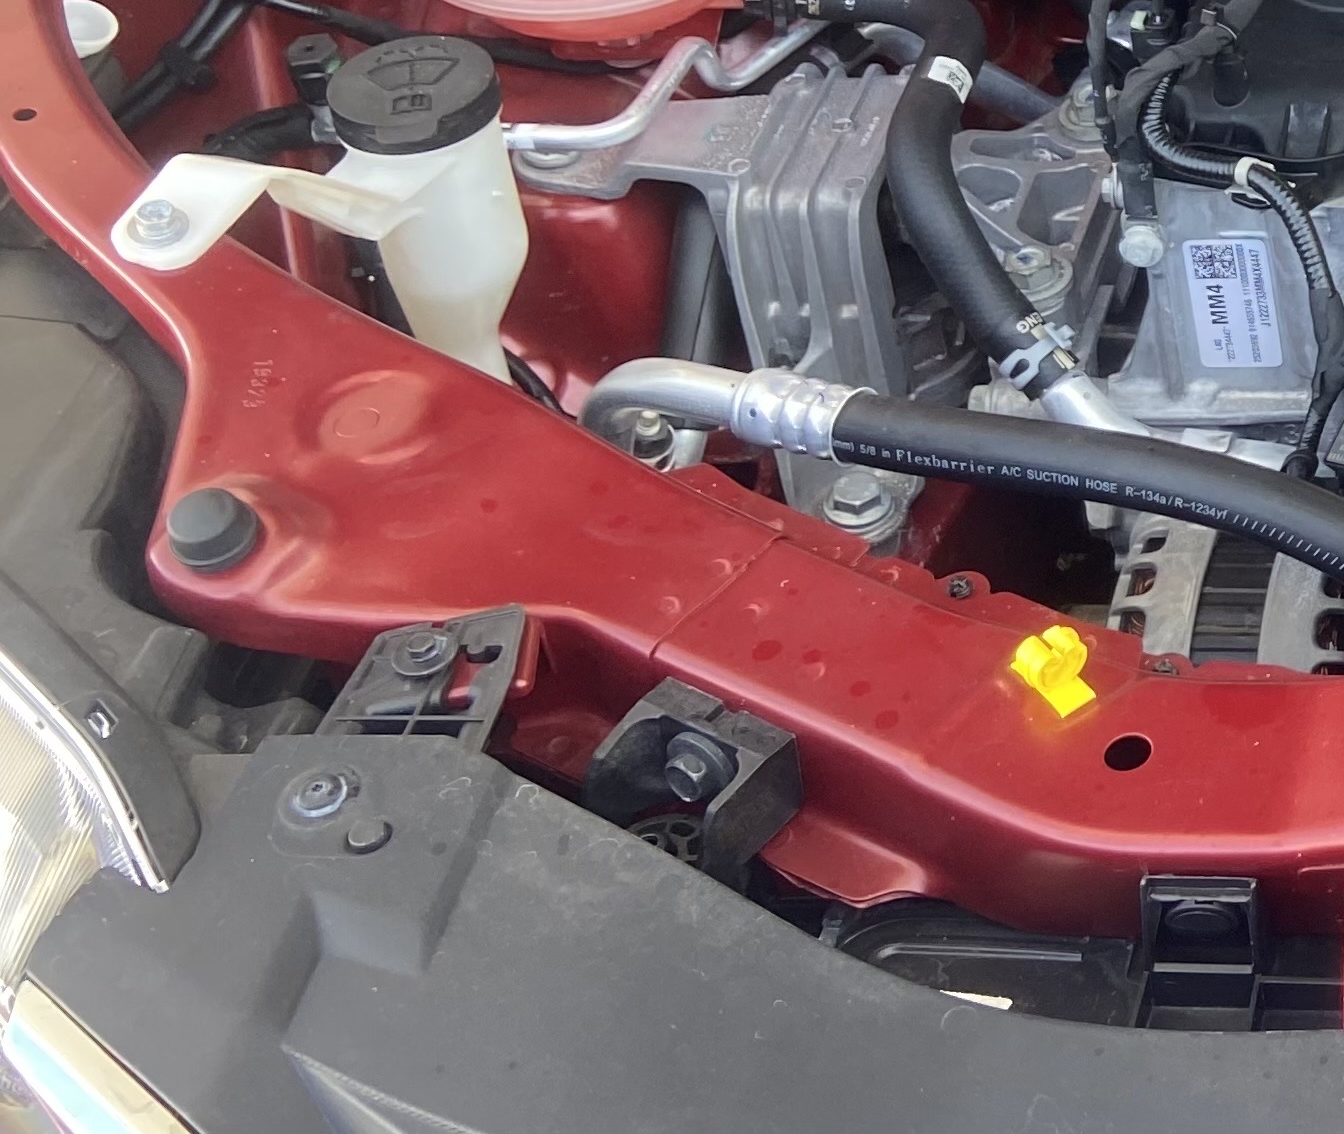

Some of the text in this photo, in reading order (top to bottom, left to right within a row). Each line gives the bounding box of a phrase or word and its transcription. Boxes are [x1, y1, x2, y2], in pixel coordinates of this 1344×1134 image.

[1206, 285, 1229, 324] MM4
[860, 444, 876, 456] 5/8
[882, 448, 891, 459] in
[896, 449, 994, 475] Flexbarrier
[1001, 466, 1022, 478] A/C
[1027, 469, 1079, 487] SUCTION
[1086, 478, 1118, 494] HOSE
